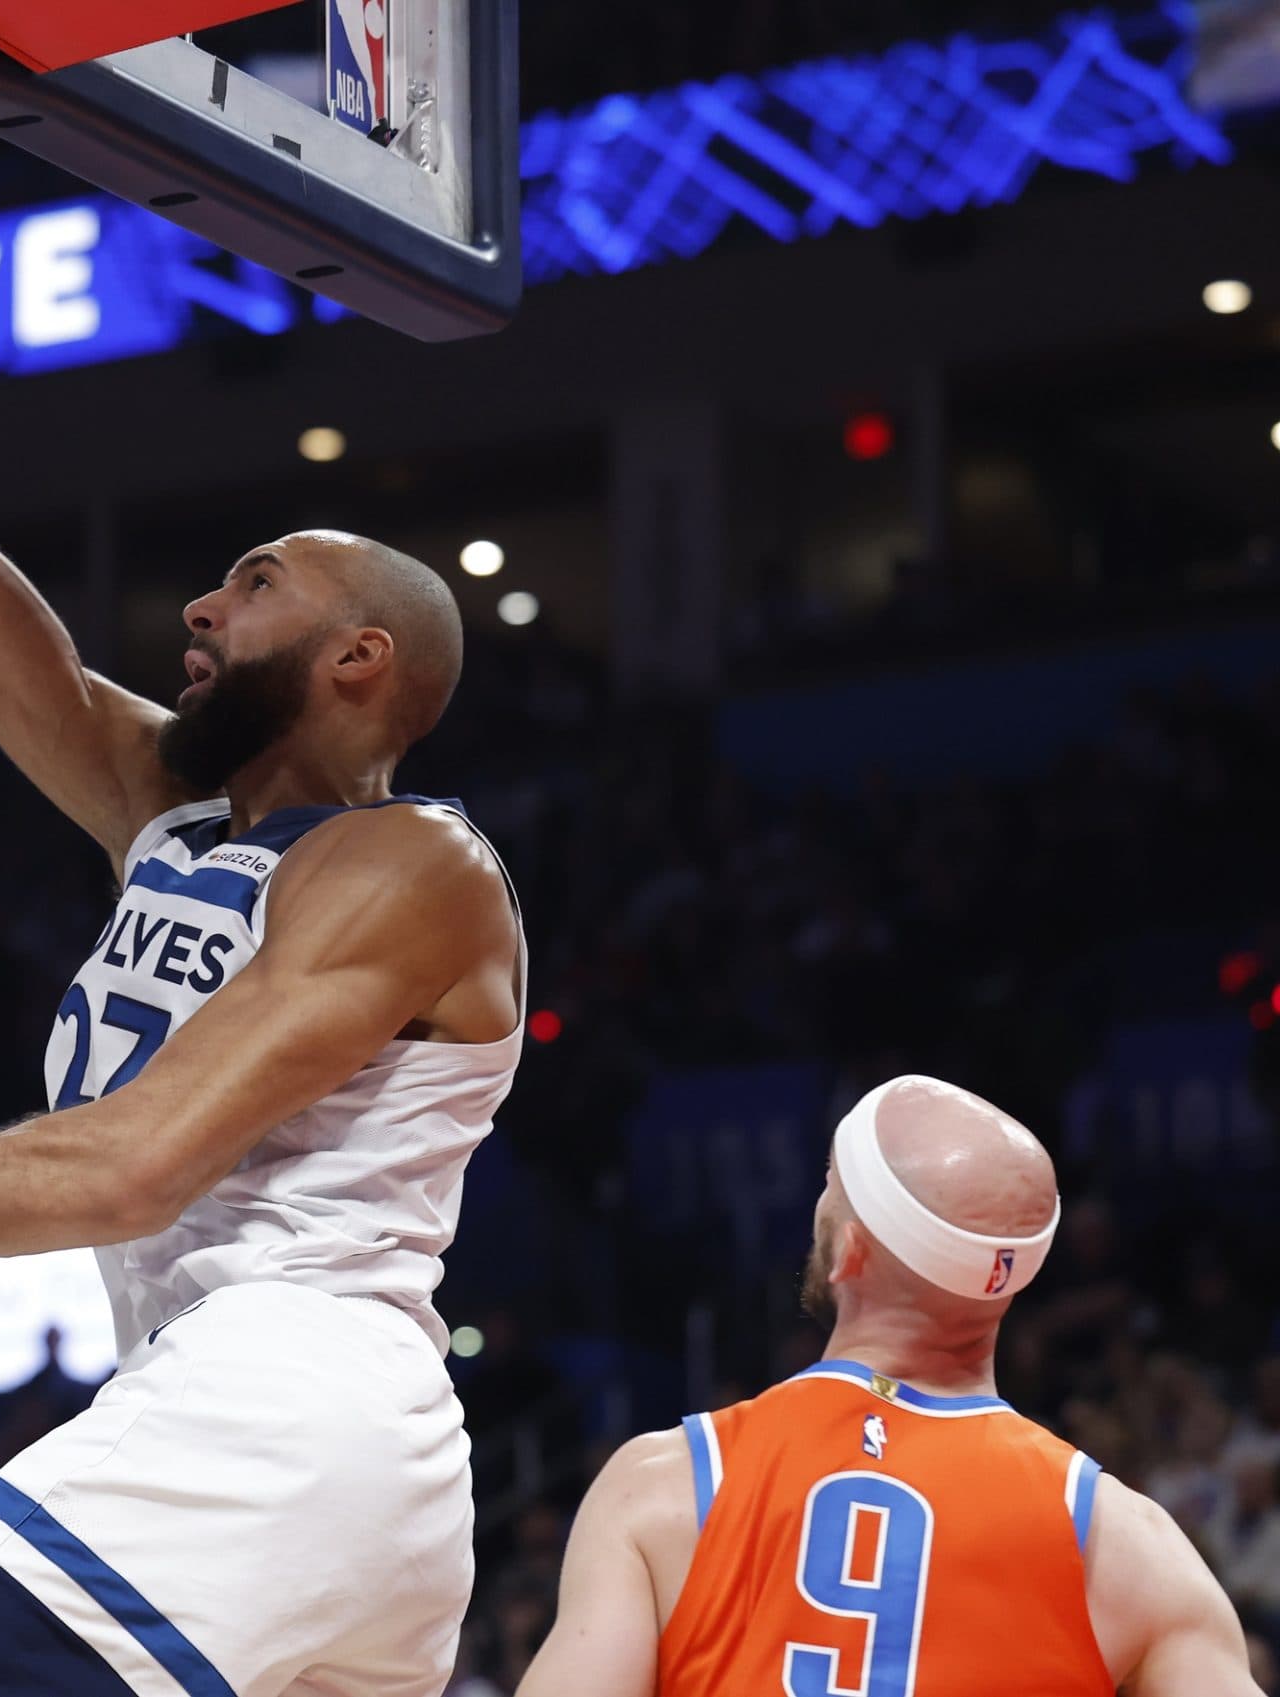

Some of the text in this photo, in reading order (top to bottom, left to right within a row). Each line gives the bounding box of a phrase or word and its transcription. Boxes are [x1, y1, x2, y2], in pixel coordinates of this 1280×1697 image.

[335, 68, 366, 122] NBA
[216, 852, 268, 873] sezzle
[94, 907, 235, 994] LVES
[54, 982, 172, 1109] 27
[782, 1470, 934, 1697] 9
